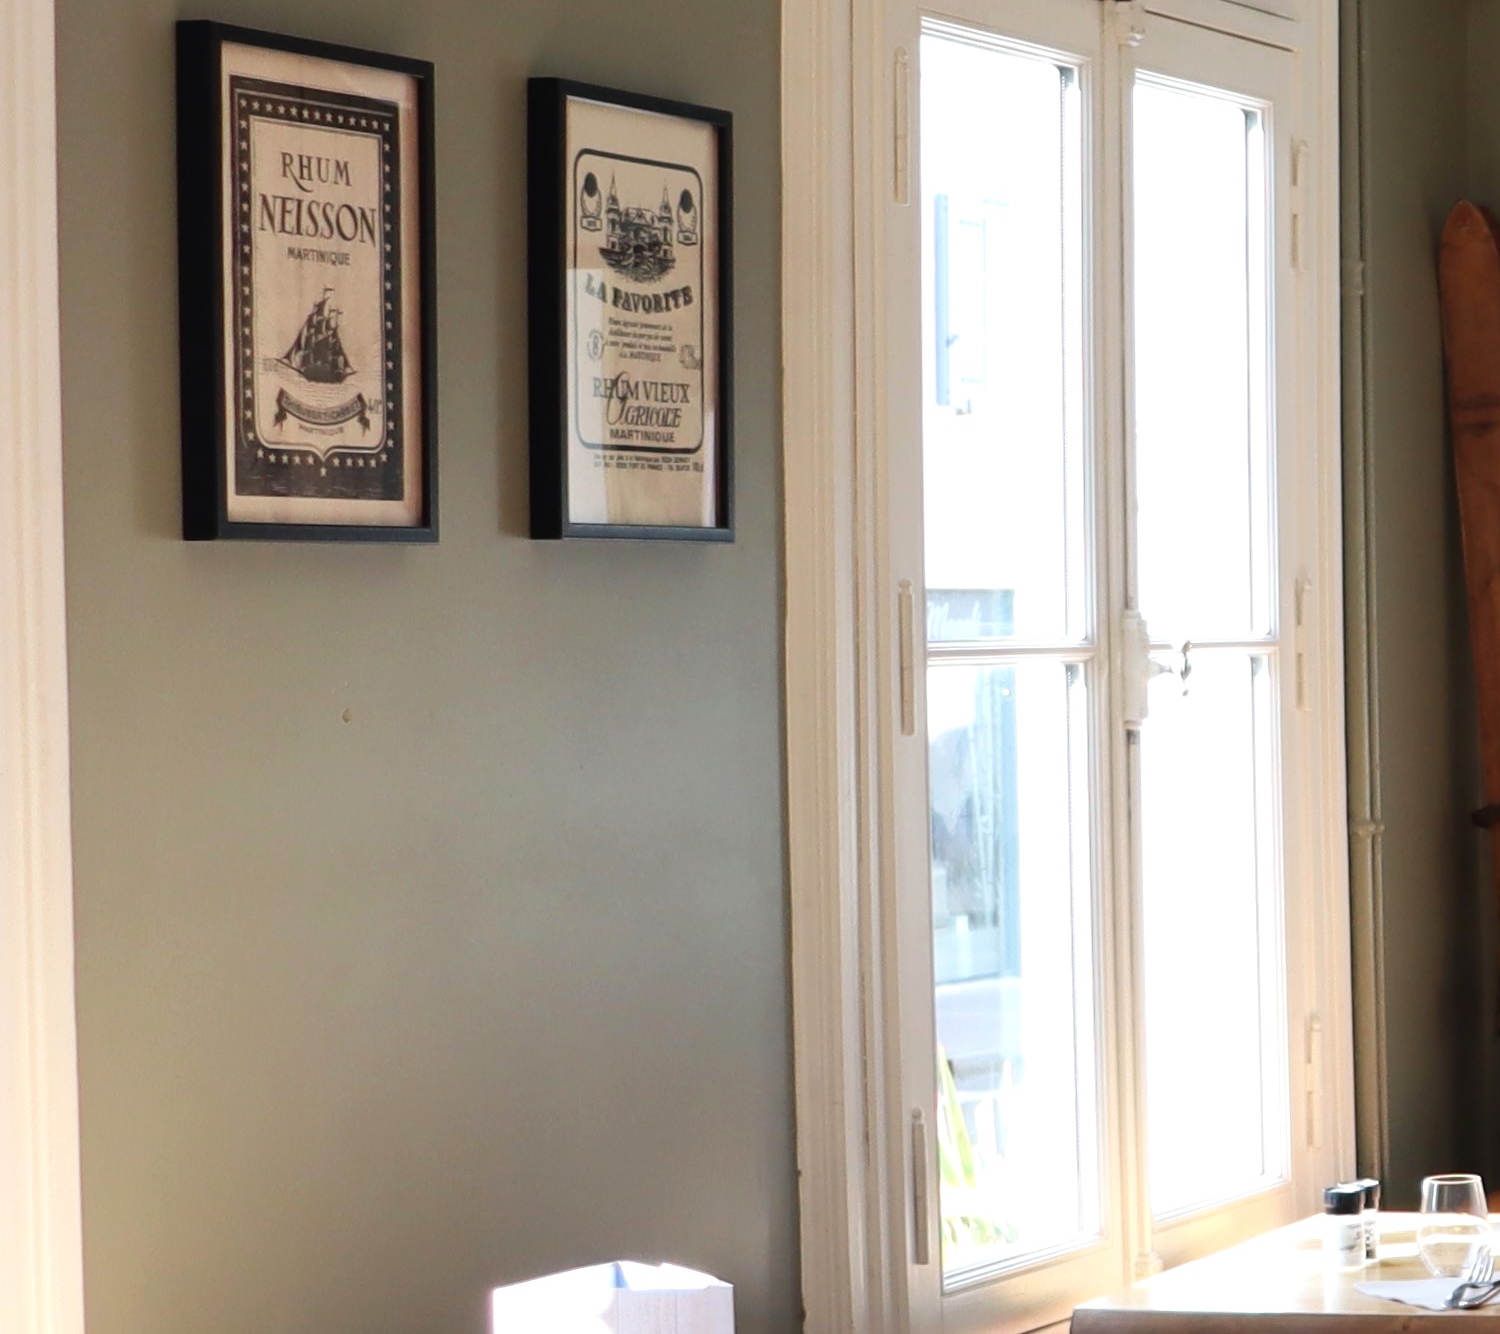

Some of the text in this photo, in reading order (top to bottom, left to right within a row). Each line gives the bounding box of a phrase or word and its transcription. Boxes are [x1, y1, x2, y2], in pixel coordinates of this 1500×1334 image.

[280, 151, 352, 193] RHUM
[258, 193, 377, 248] NEISSON
[287, 246, 351, 267] MARTINIQUE
[585, 272, 694, 314] LA FAVORITE
[642, 380, 691, 405] VIEUX
[609, 428, 675, 445] MARTINIQUE
